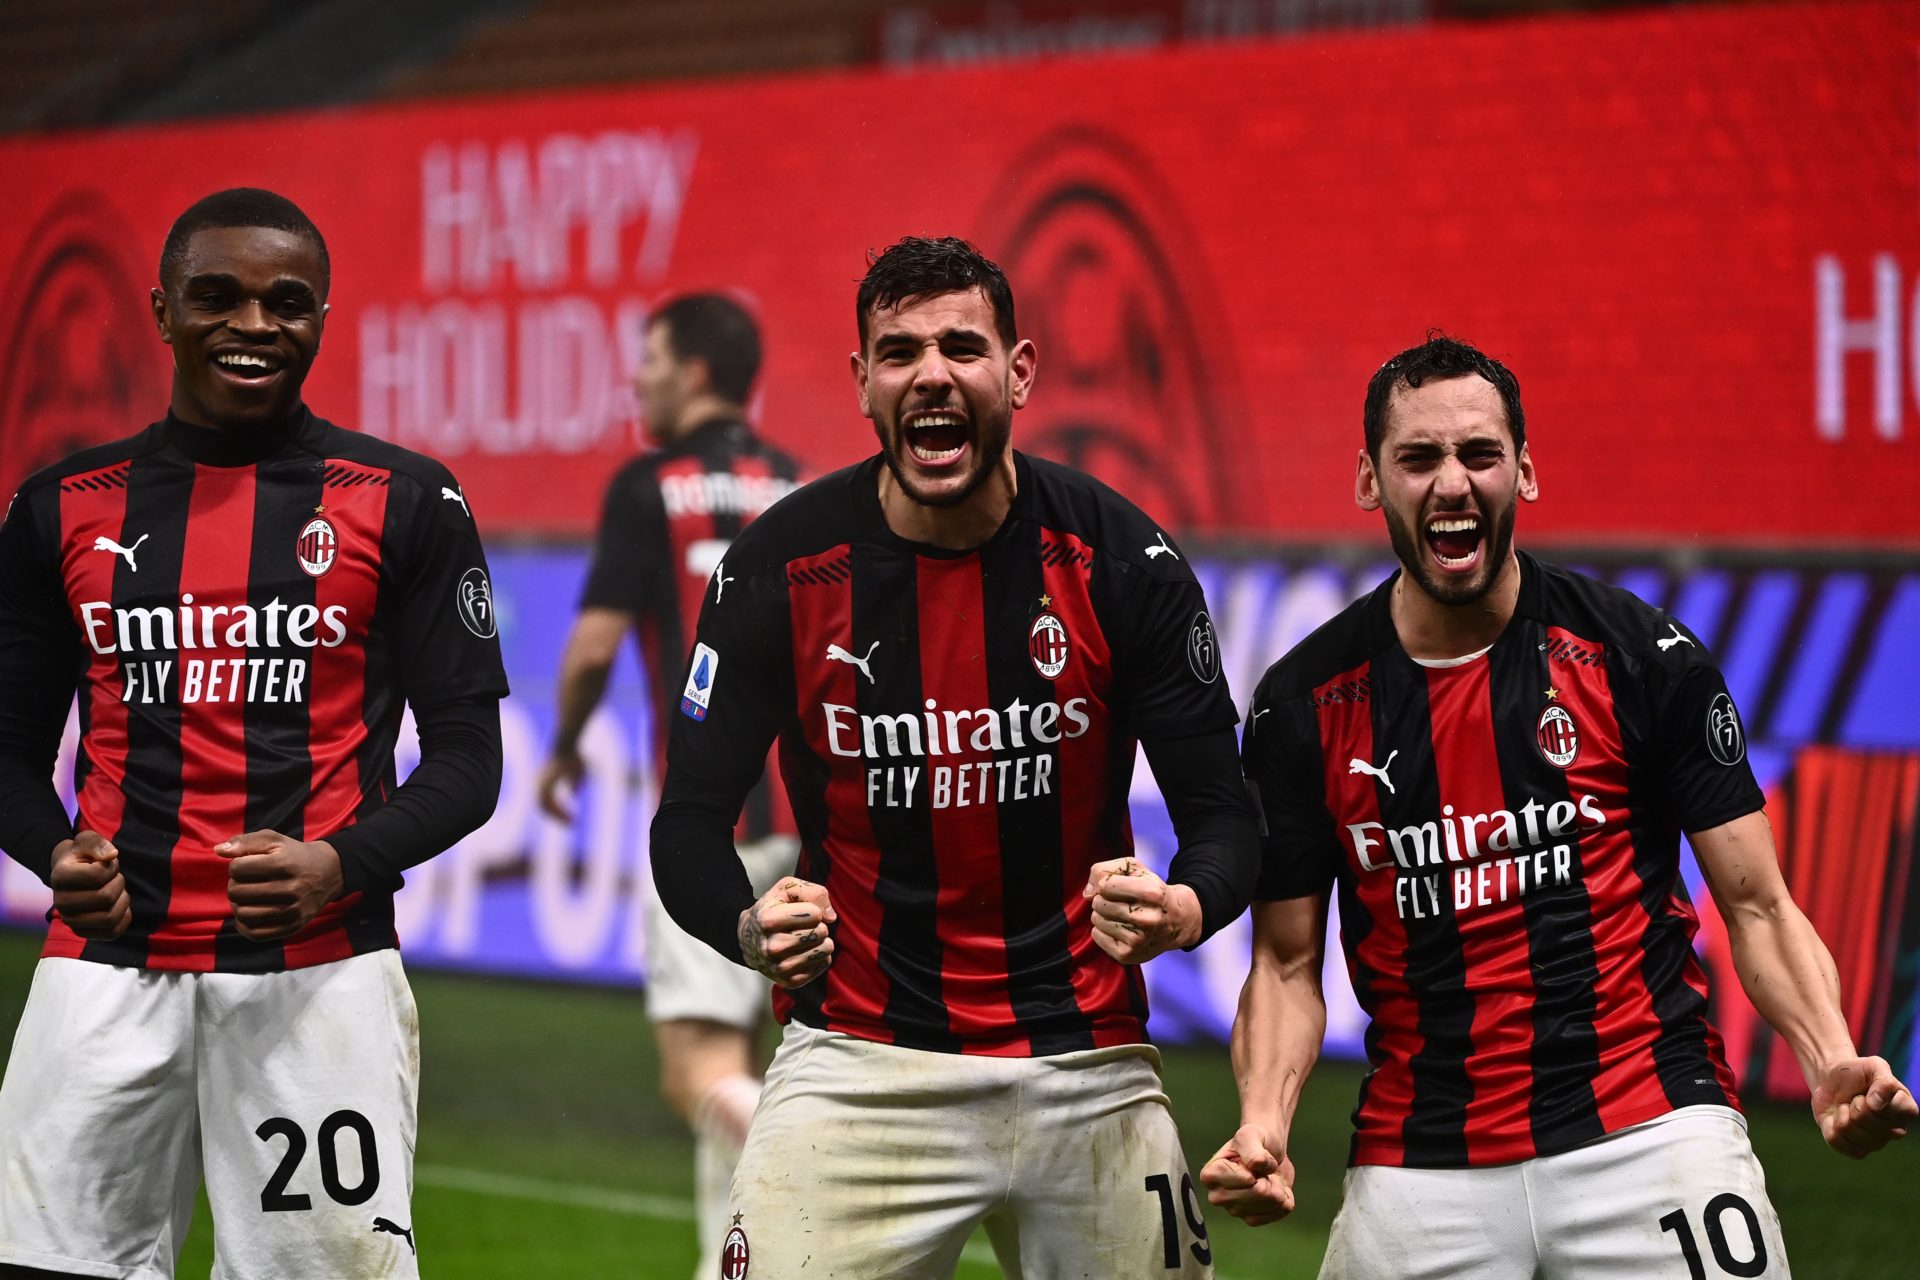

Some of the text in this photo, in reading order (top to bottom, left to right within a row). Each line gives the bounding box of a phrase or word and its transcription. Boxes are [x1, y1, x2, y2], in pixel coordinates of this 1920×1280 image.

[422, 129, 700, 291] HAPPY
[1815, 253, 1920, 440] H
[307, 520, 330, 532] ACM
[306, 562, 327, 571] 1899
[80, 594, 347, 655] Emirates
[476, 601, 487, 620] 7
[1036, 616, 1060, 630] ACM
[123, 658, 306, 704] FLY BETTER
[823, 697, 1089, 758] Emirates
[1544, 708, 1568, 722] ACM
[1724, 726, 1733, 747] 7
[867, 754, 1053, 808] FLY BETTER
[1552, 754, 1572, 762] 1899
[1345, 794, 1607, 872] Emirates
[1396, 844, 1572, 919] FLY BETTER
[255, 1109, 380, 1213] 20
[1145, 1172, 1212, 1269] 19
[1660, 1192, 1768, 1280] 10
